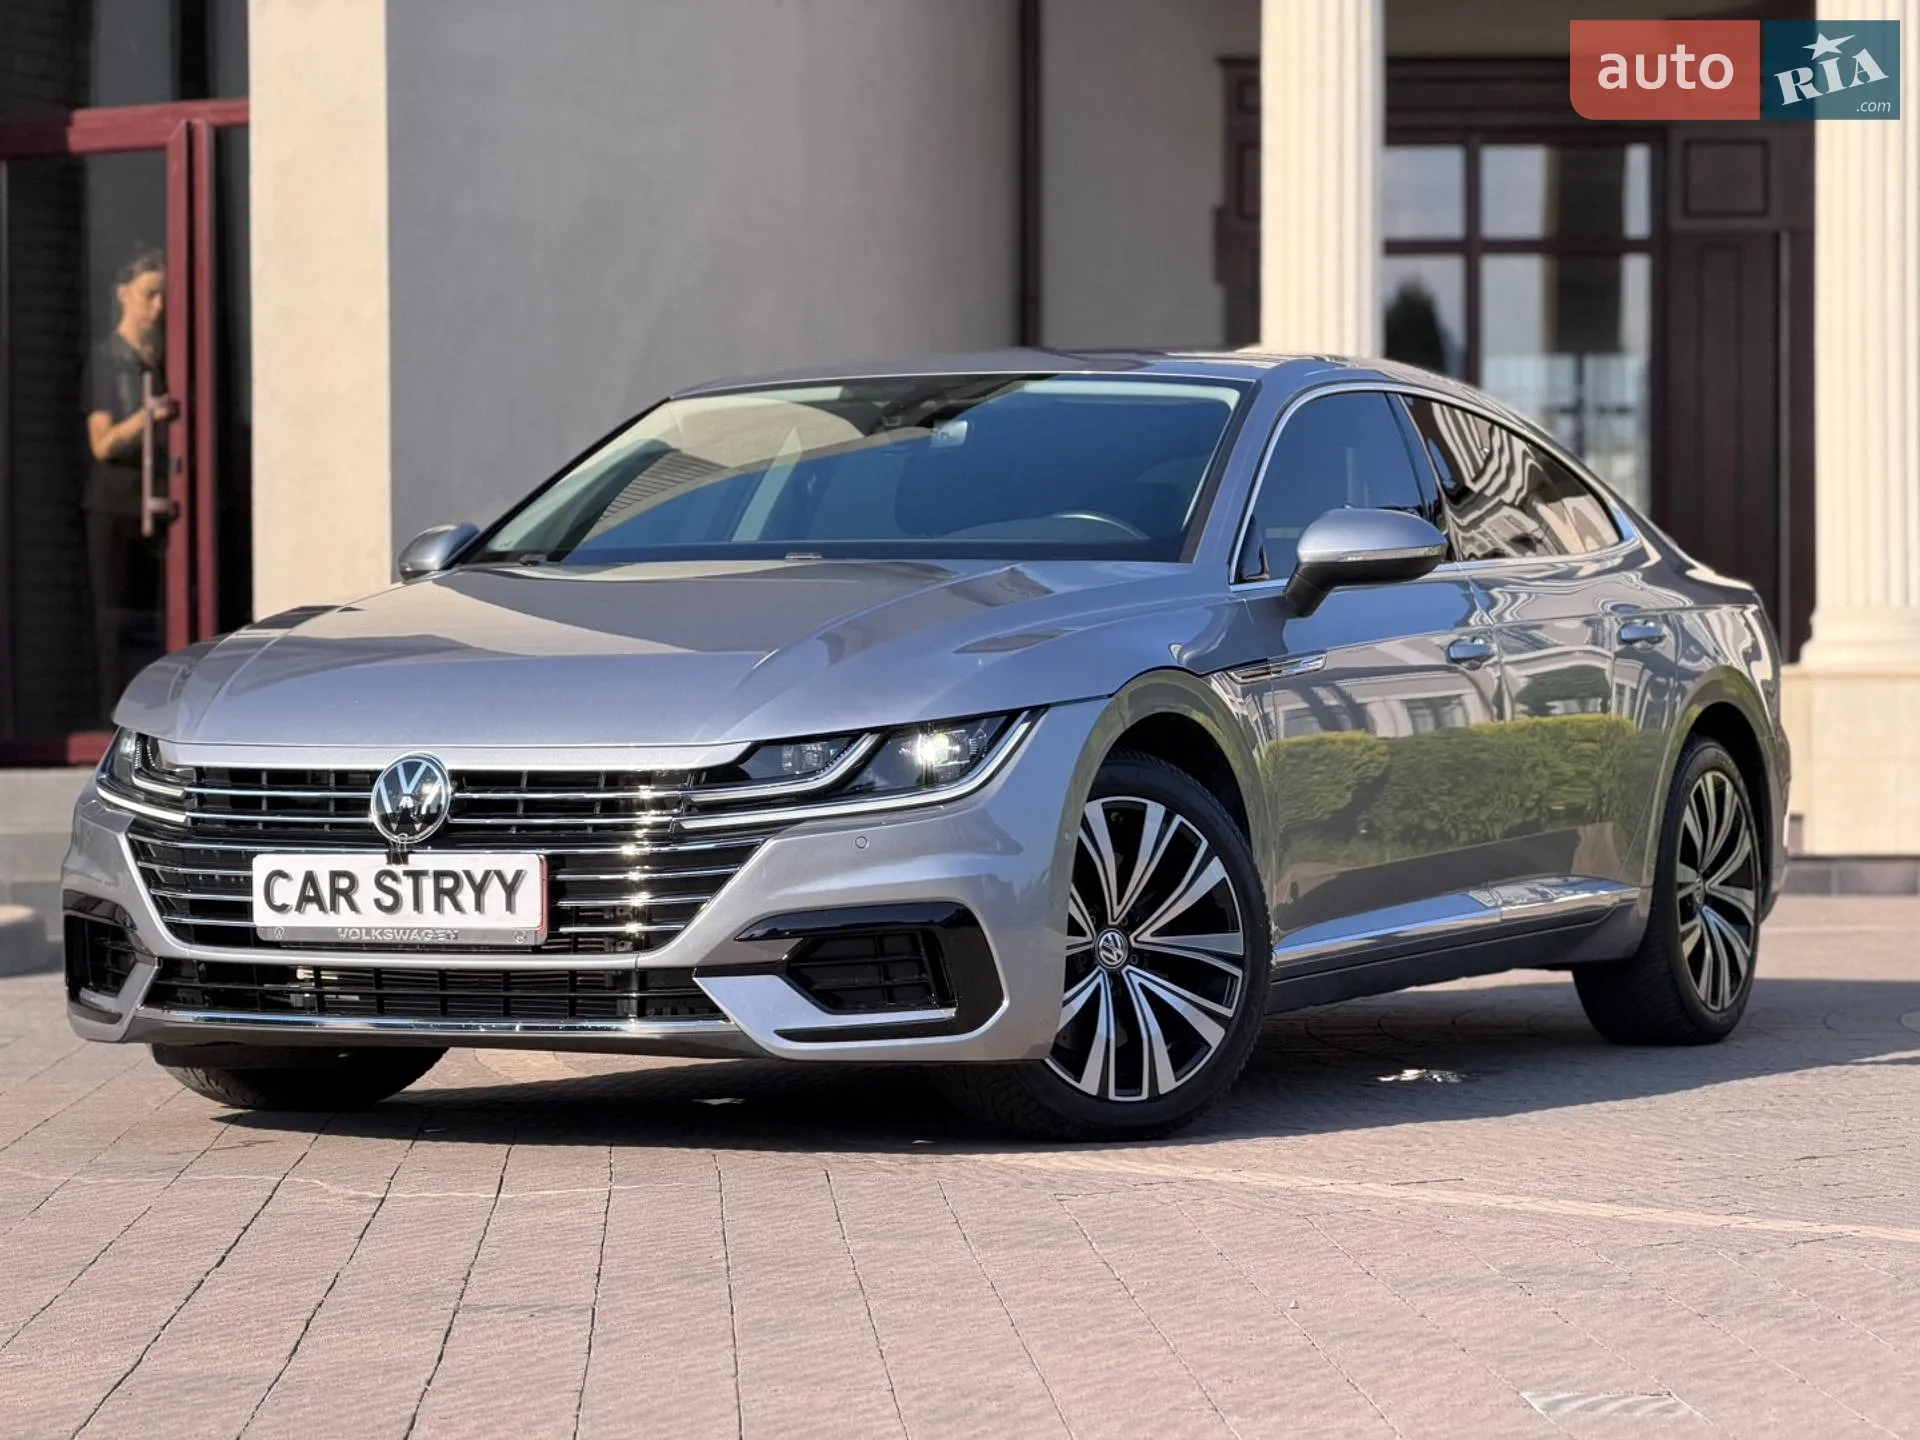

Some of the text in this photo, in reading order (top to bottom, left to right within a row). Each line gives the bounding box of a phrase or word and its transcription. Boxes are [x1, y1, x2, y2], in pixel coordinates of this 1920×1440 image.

[263, 869, 527, 914] CAR STRYY
[337, 927, 459, 941] VOLKSWAGEN
